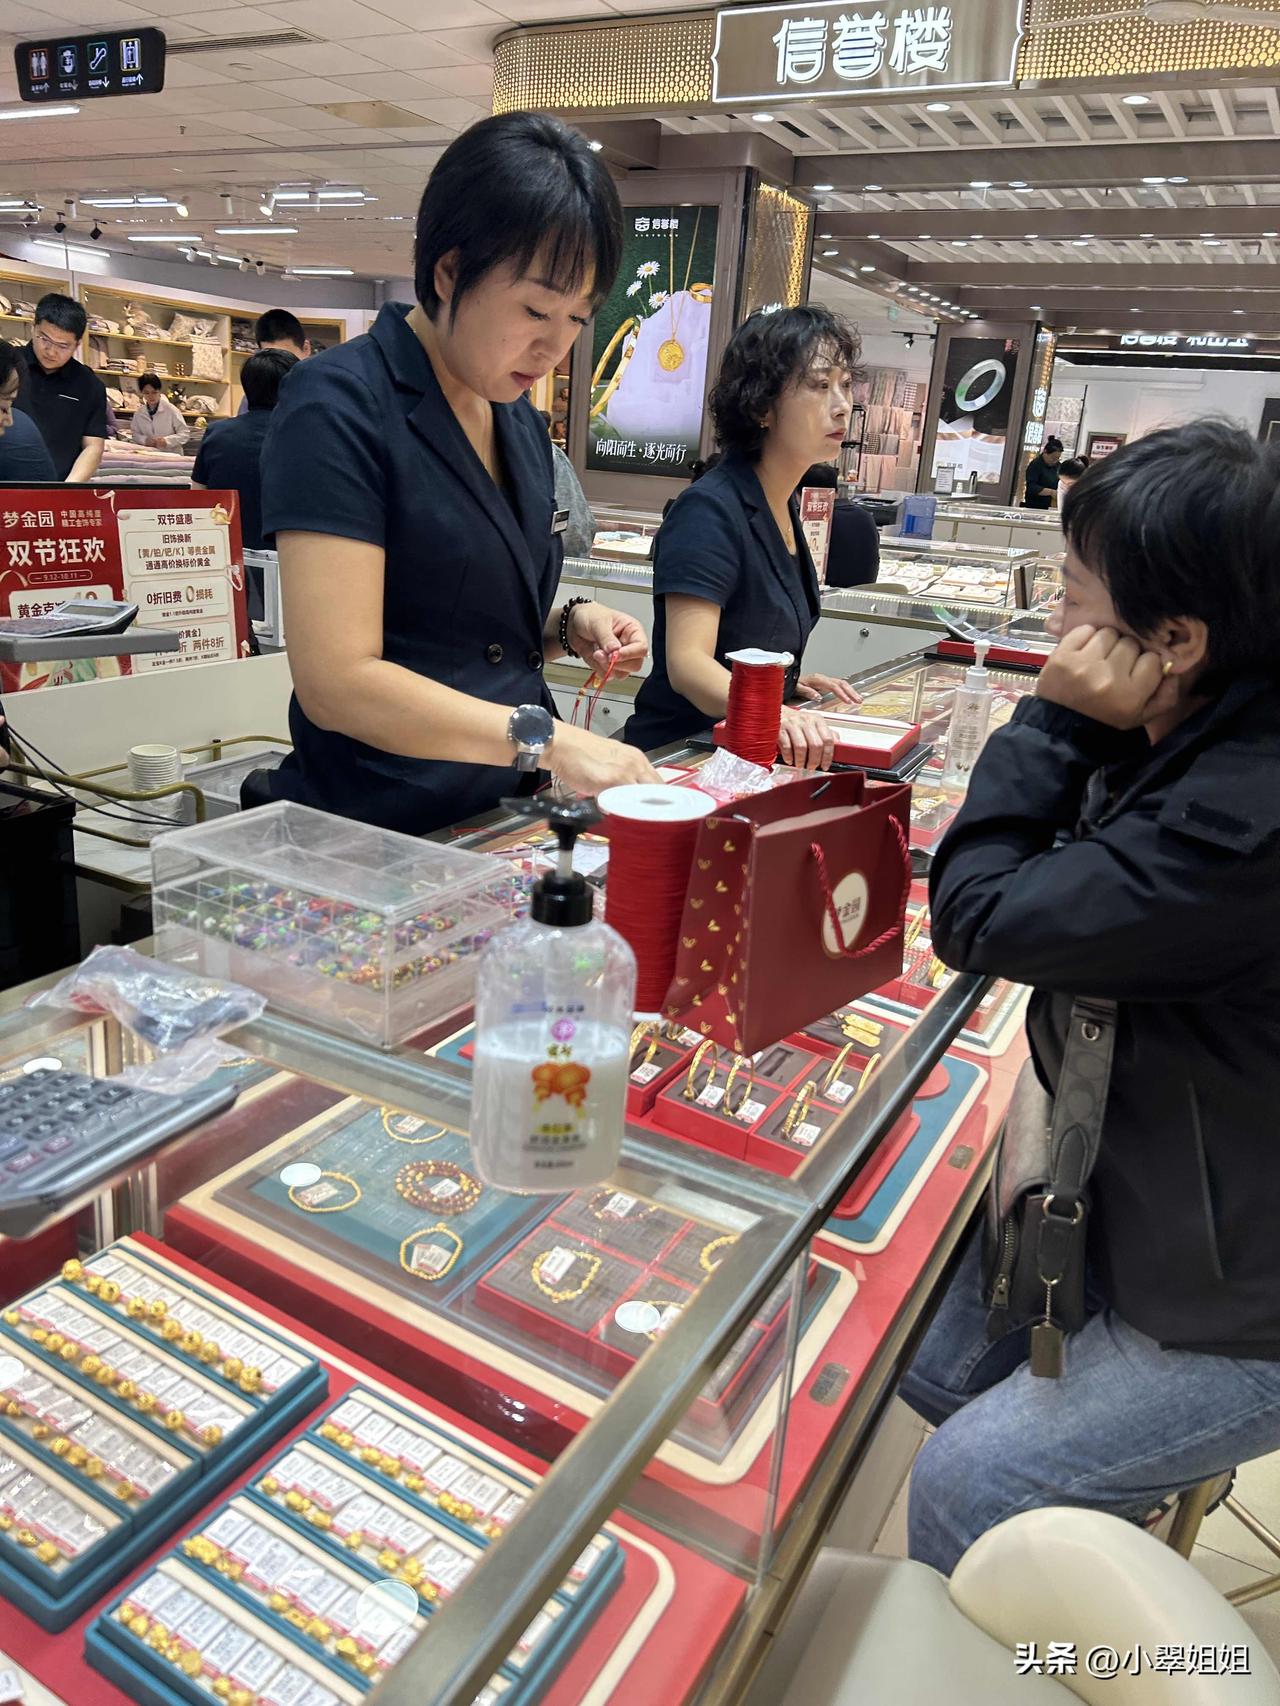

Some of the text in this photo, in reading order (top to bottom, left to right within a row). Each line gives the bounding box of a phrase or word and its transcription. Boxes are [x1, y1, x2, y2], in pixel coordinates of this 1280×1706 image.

[772, 6, 952, 85] 信誉楼
[2, 510, 55, 528] 梦金园
[157, 513, 194, 526] 双节盛惠
[162, 533, 192, 544] 旧饰换新
[6, 536, 106, 567] 双节狂欢
[192, 636, 225, 652] 两件8折
